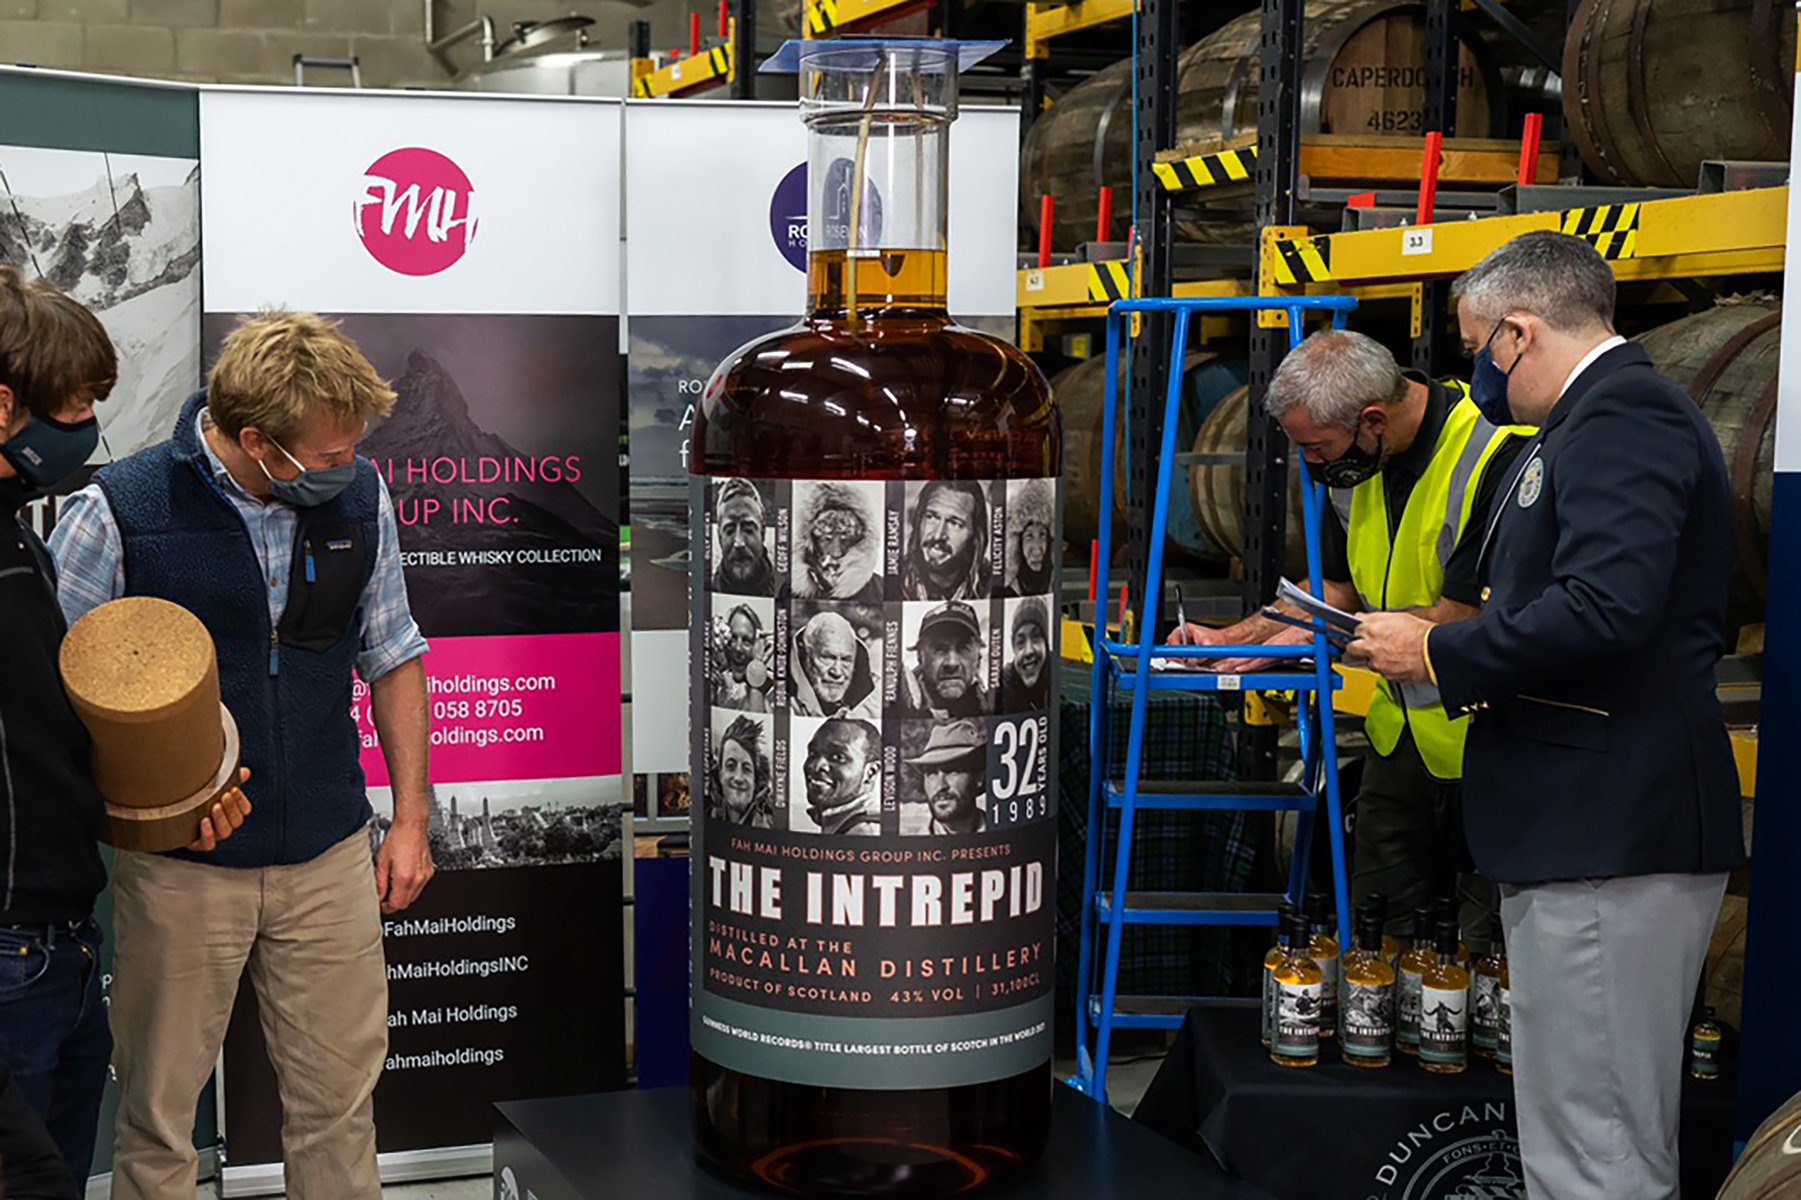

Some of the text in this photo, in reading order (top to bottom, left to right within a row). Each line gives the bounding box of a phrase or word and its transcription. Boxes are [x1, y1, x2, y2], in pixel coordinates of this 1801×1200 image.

[1332, 67, 1474, 88] CAPERDOH
[407, 456, 582, 484] HOLDINGS
[452, 497, 519, 525] INC.
[458, 549, 515, 565] WHISKY
[516, 548, 602, 564] COLLECTION
[777, 508, 788, 573] GEOFF WILSON
[887, 510, 900, 575] JAMIE RAMSAY
[992, 506, 1004, 576] FELICITY ASTON
[885, 620, 899, 702] RANULPH FIENNES
[991, 659, 1001, 688] SARAH
[434, 701, 470, 719] 058
[475, 698, 522, 718] 8705
[992, 718, 1038, 799] 32
[1037, 716, 1048, 791] YEARS OLD
[775, 739, 787, 808] DWAYNE FIELDS
[884, 745, 896, 811] LEVISON WOOD
[992, 795, 1046, 824] 1989
[731, 837, 1011, 863] FAH MAI HOLDINGS GROUP INC. PRESENTS
[709, 855, 1043, 927] THE INTREPID
[381, 915, 516, 937] FahMaiHoldings
[709, 920, 852, 954] DISTILLED AT THE
[709, 938, 1041, 978] MACALLAN DISTILLERY
[709, 968, 759, 991] PRODUCT
[764, 982, 782, 994] OF
[788, 985, 872, 1002] SCOTLAND
[890, 991, 923, 1003] 43%
[931, 988, 963, 1001] VOL
[411, 1008, 442, 1026] Mai
[446, 1004, 518, 1022] Holdings
[731, 1027, 759, 1042] WORLD
[814, 1041, 841, 1053] TITLE
[844, 1044, 892, 1055] LARGEST
[893, 1044, 933, 1055] BOTTLE
[934, 1043, 949, 1053] OF
[951, 1038, 988, 1052] SCOTCH
[990, 1038, 998, 1047] IN
[999, 1033, 1014, 1044] THE
[1375, 1102, 1505, 1186] DUNCAN
[1443, 1143, 1482, 1164] FONS
